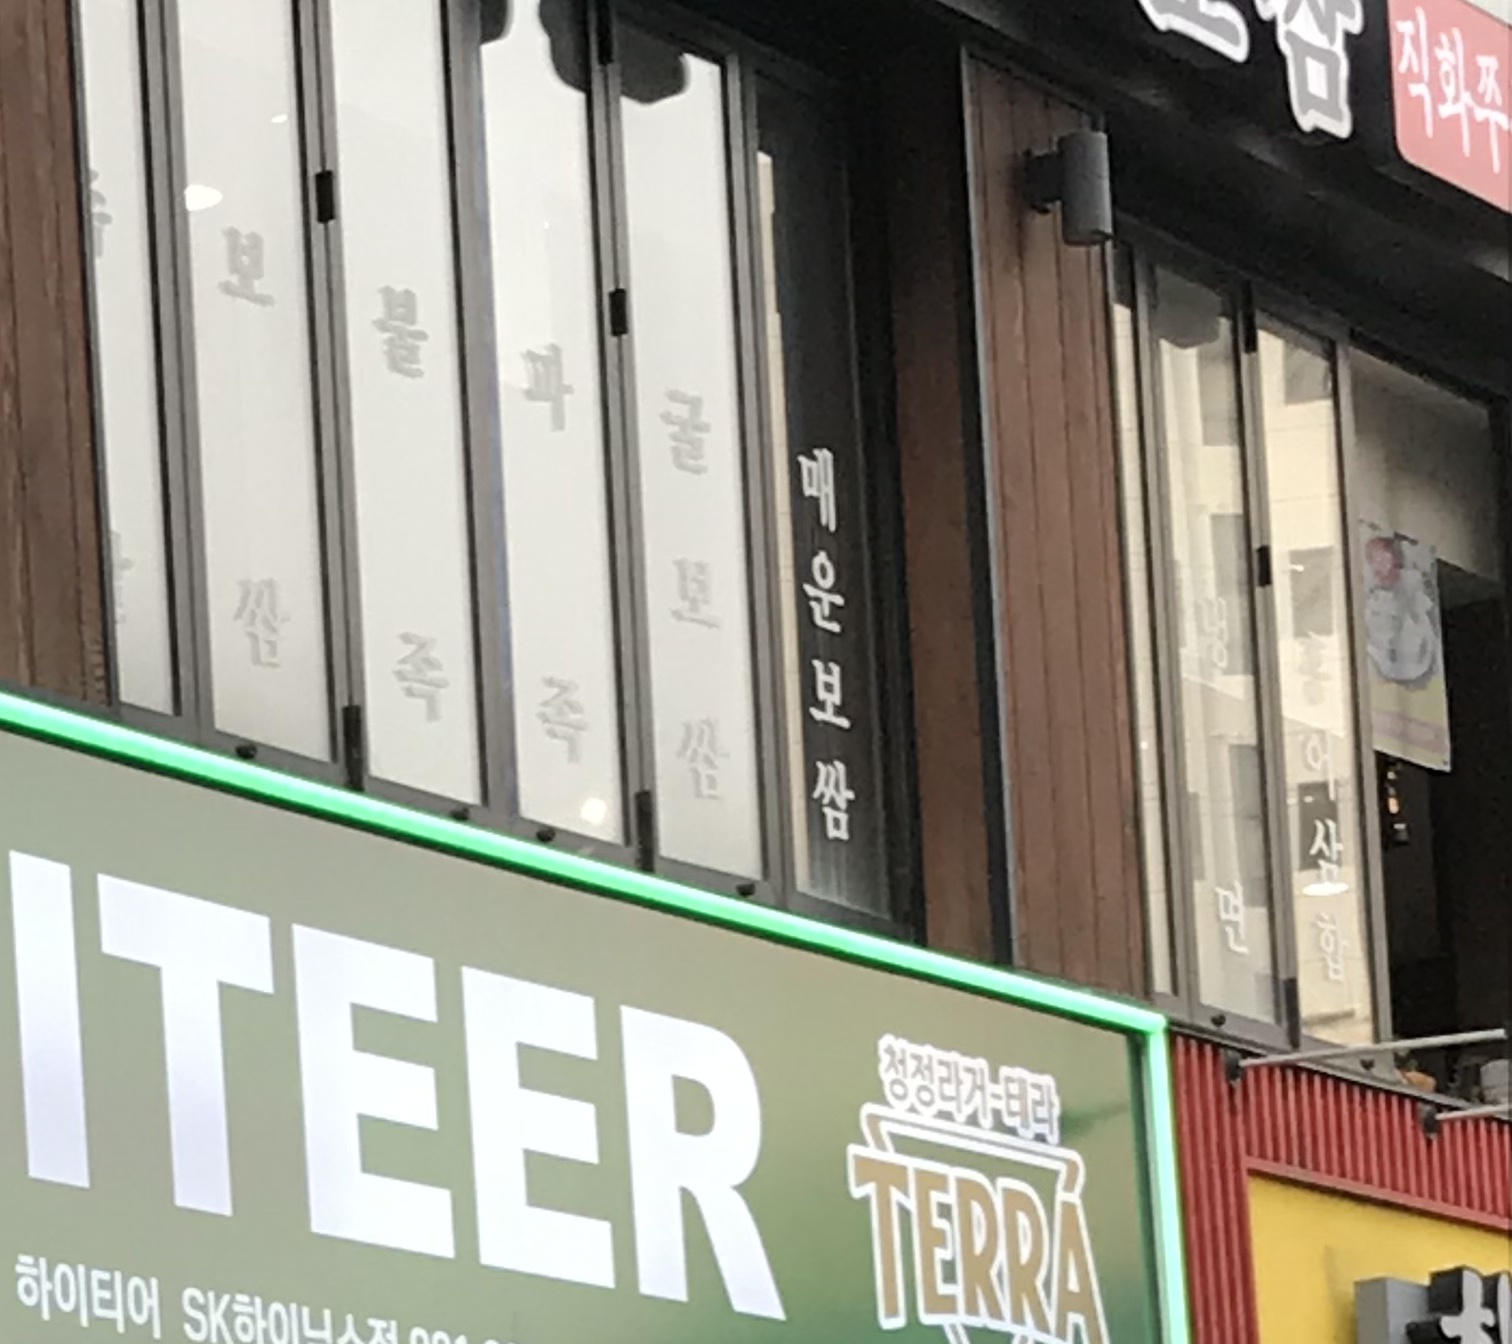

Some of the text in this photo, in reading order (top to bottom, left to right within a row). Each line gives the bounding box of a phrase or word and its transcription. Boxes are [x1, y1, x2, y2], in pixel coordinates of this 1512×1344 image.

[796, 446, 857, 843] 매운보쌈
[880, 1038, 1060, 1142] 청정라거-테라
[15, 1253, 161, 1340] 하이티어
